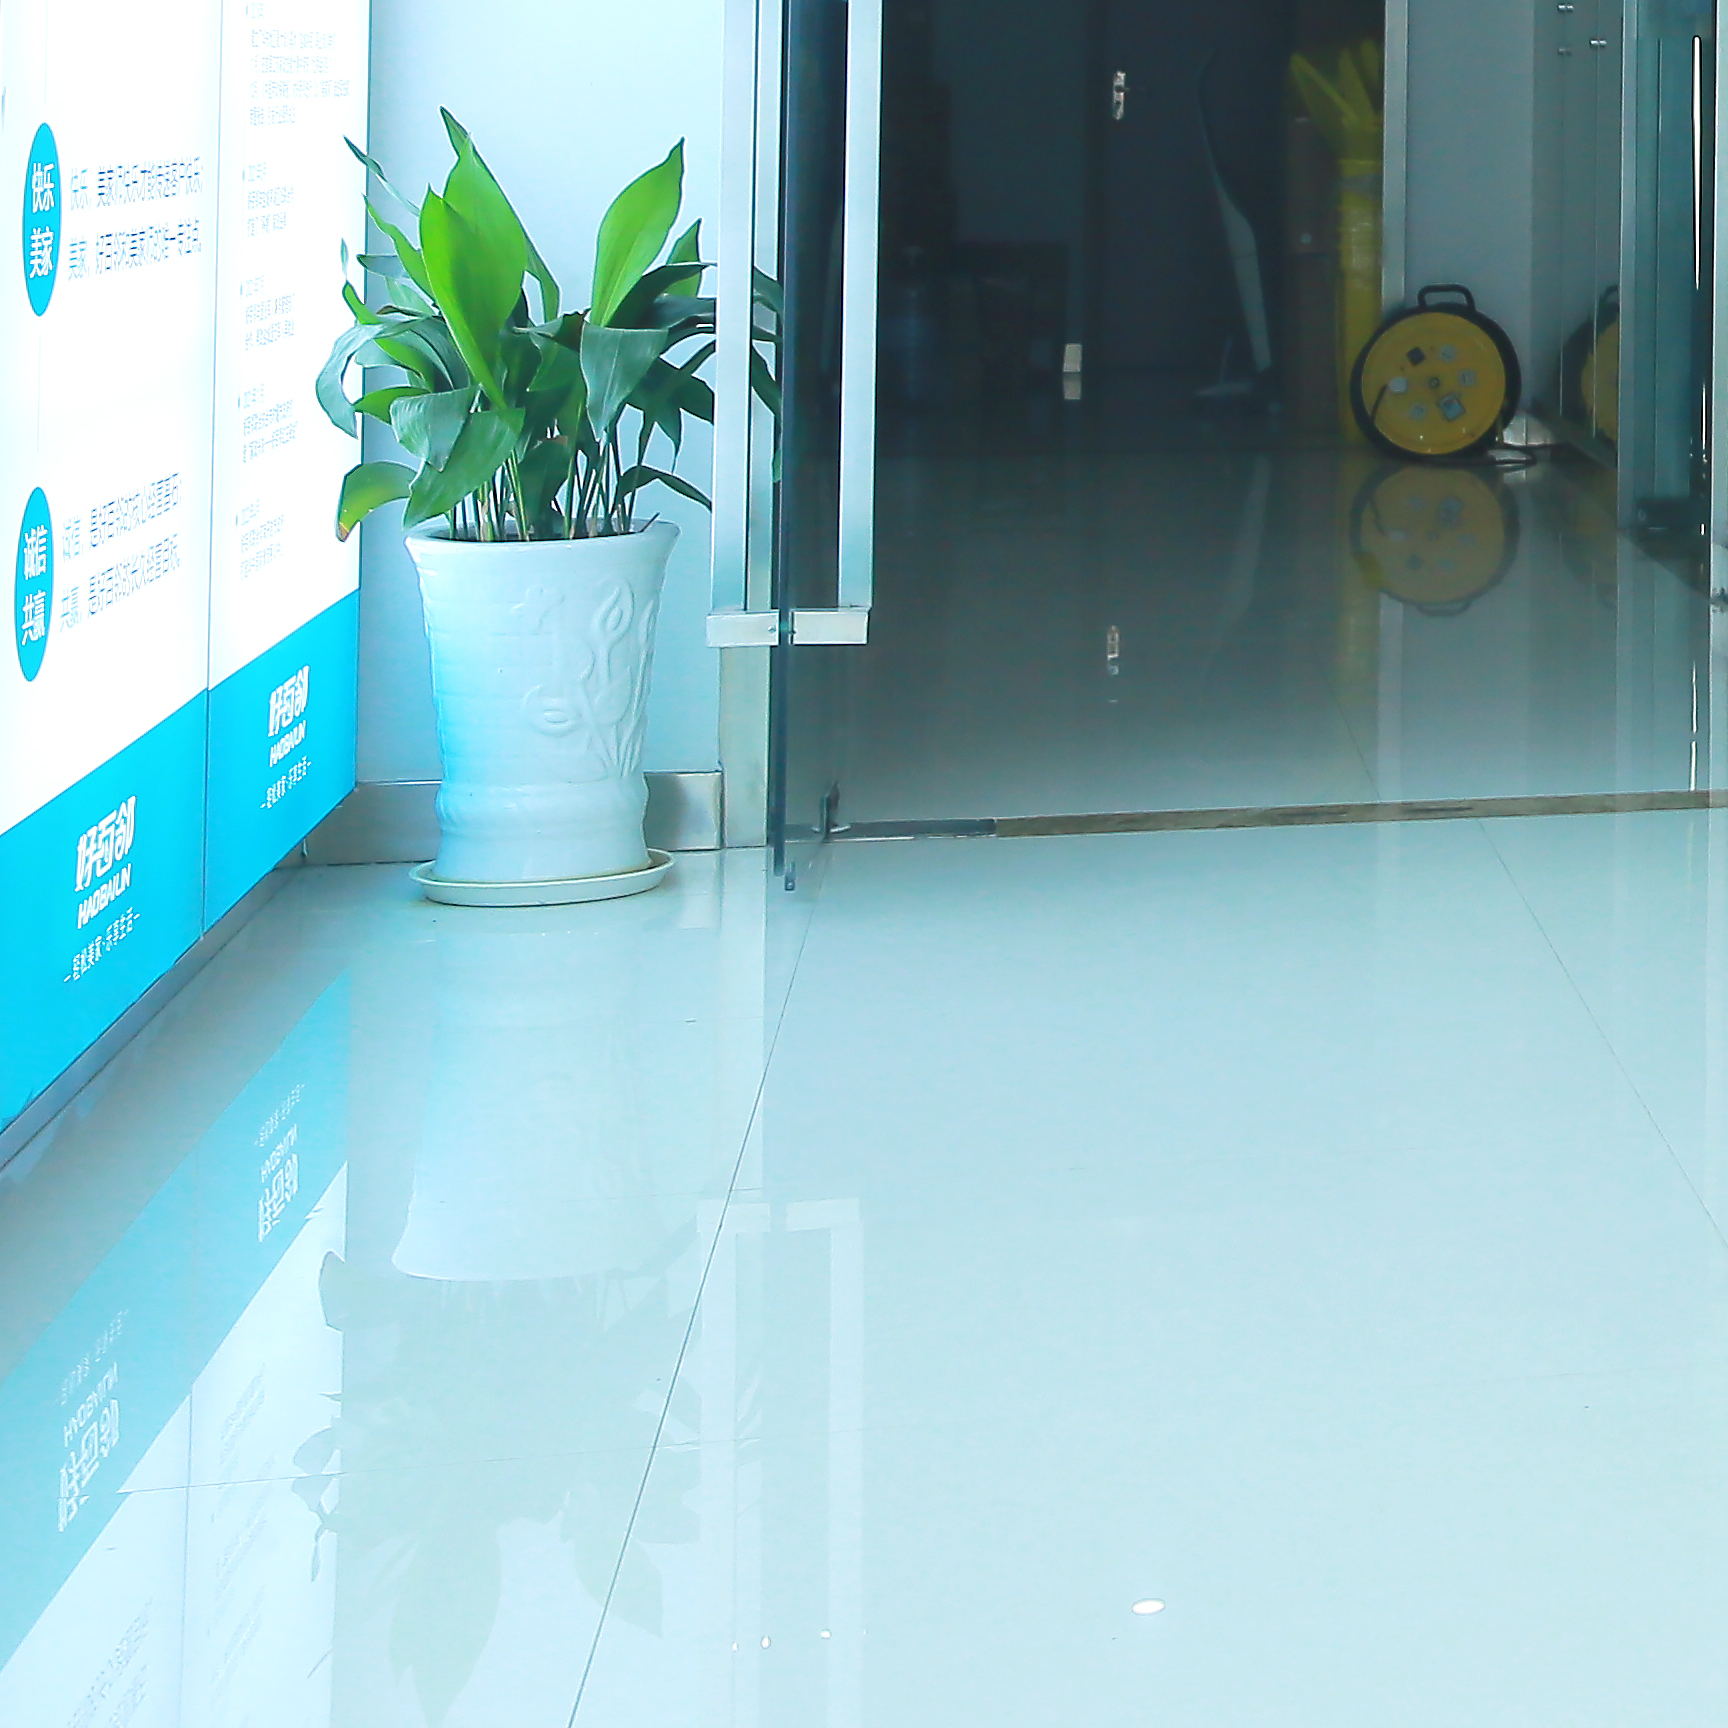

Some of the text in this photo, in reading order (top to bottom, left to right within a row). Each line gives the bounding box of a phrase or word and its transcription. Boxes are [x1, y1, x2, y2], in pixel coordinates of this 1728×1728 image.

[31, 162, 56, 214] 快乐
[29, 225, 54, 279] 美家
[23, 524, 49, 581] 诚信
[21, 589, 47, 647] 共赢
[268, 664, 311, 738] 好百邻
[269, 719, 307, 769] HAOBAILIN
[74, 794, 137, 893] 好百邻
[77, 862, 132, 930] HAOBAILIN
